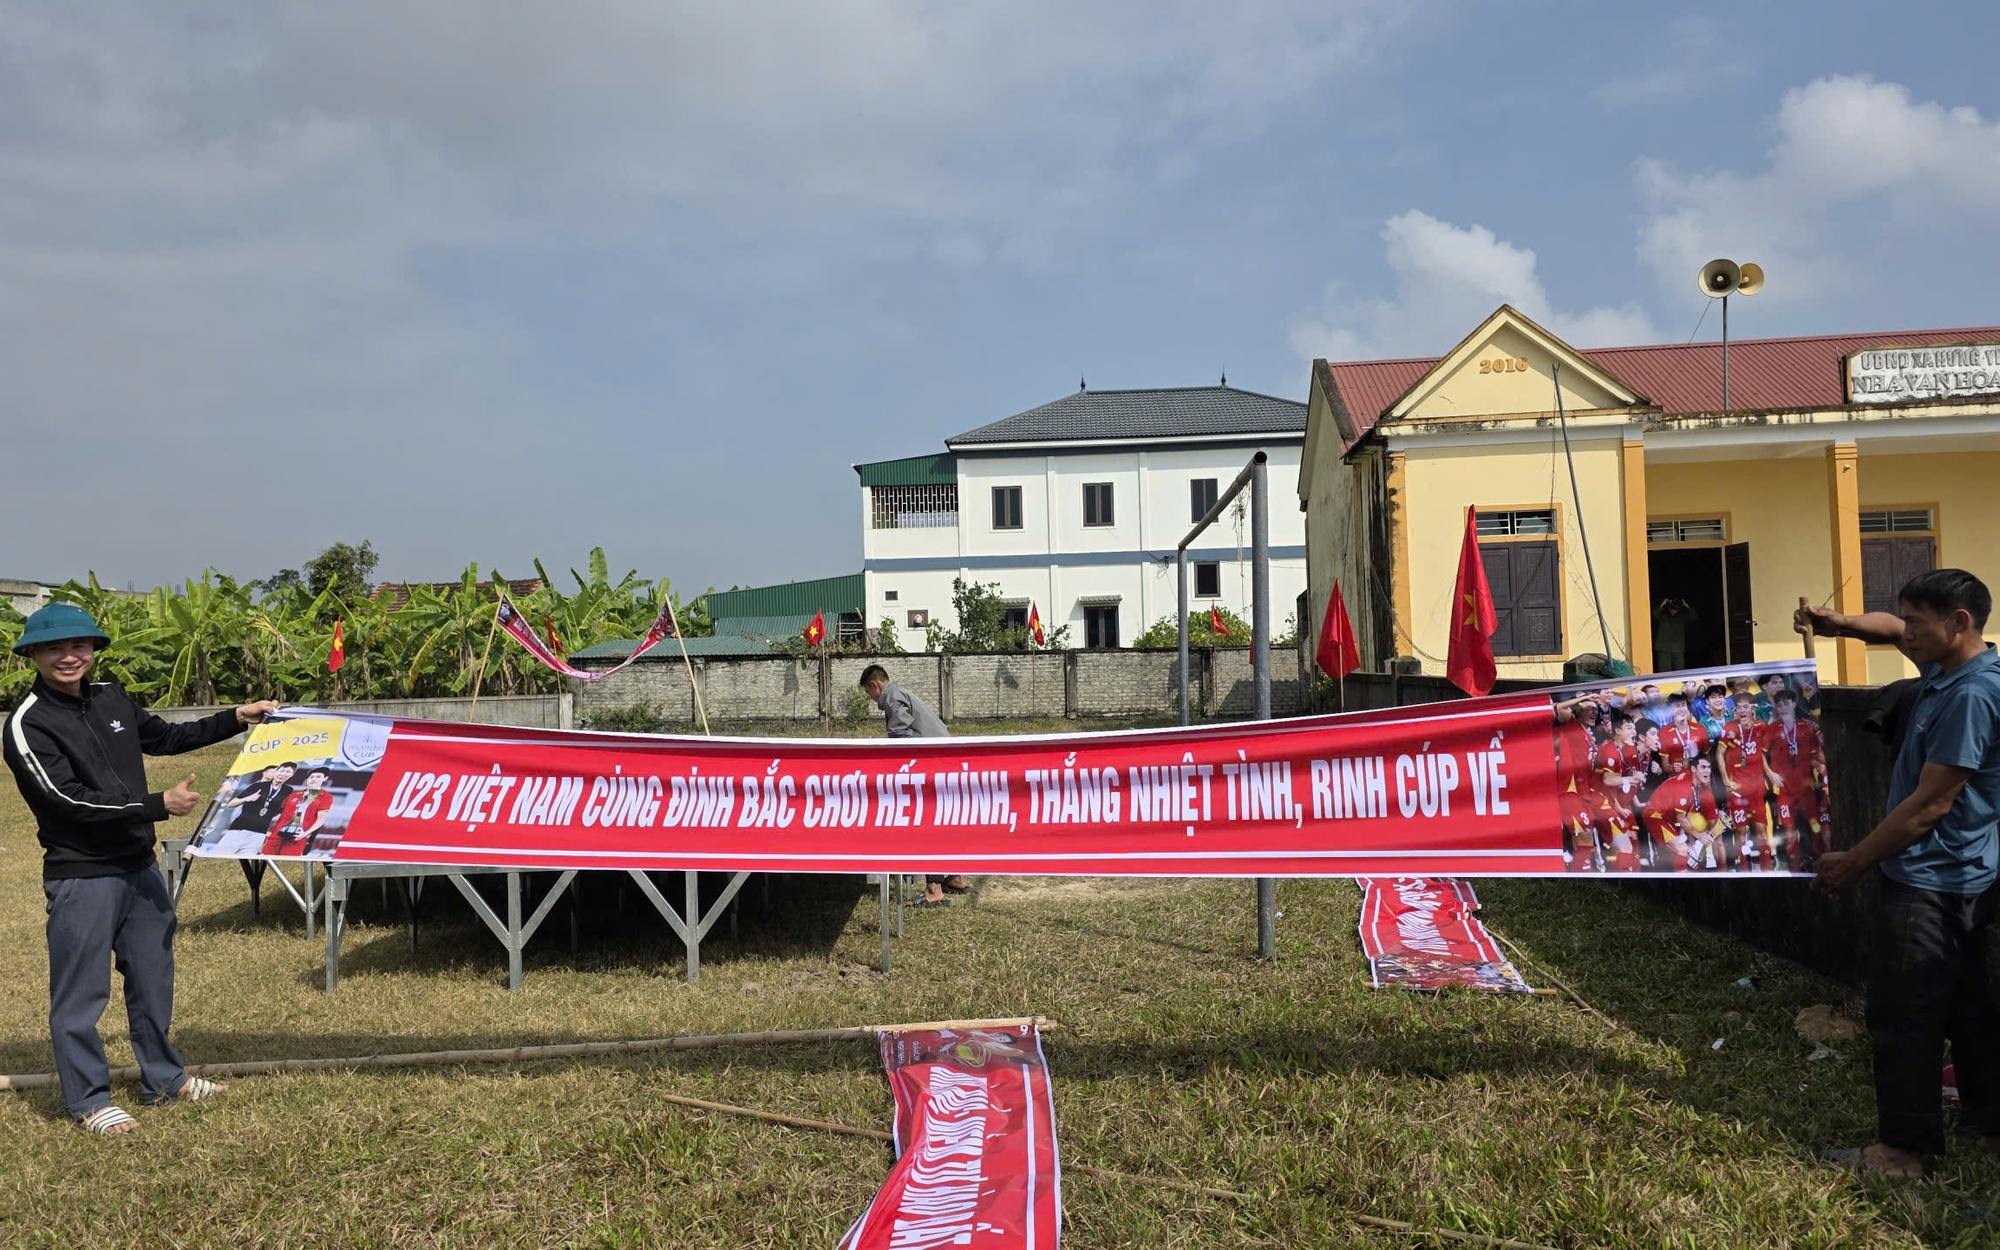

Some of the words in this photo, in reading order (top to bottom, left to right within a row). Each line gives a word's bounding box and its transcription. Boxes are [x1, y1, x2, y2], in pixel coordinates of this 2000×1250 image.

[1479, 356, 1528, 375] 2016
[1861, 352, 1909, 370] UBND
[292, 732, 328, 747] 2025
[387, 771, 451, 820] U23
[445, 763, 517, 833] VIỆT
[507, 776, 584, 826] NAM
[582, 765, 664, 828] CÙNG
[662, 766, 735, 828] ĐÌNH
[737, 758, 797, 829] BẮC
[803, 769, 869, 829] CHƠI
[874, 759, 927, 827] HẾT
[933, 762, 1018, 833] MÌNH,
[1025, 751, 1122, 824] THẮNG
[1128, 752, 1214, 837] NHIỆT
[1222, 749, 1303, 829] TÌNH,
[1310, 757, 1388, 820] RINH
[1395, 741, 1460, 819] CÚP
[1466, 729, 1511, 816] VỀ
